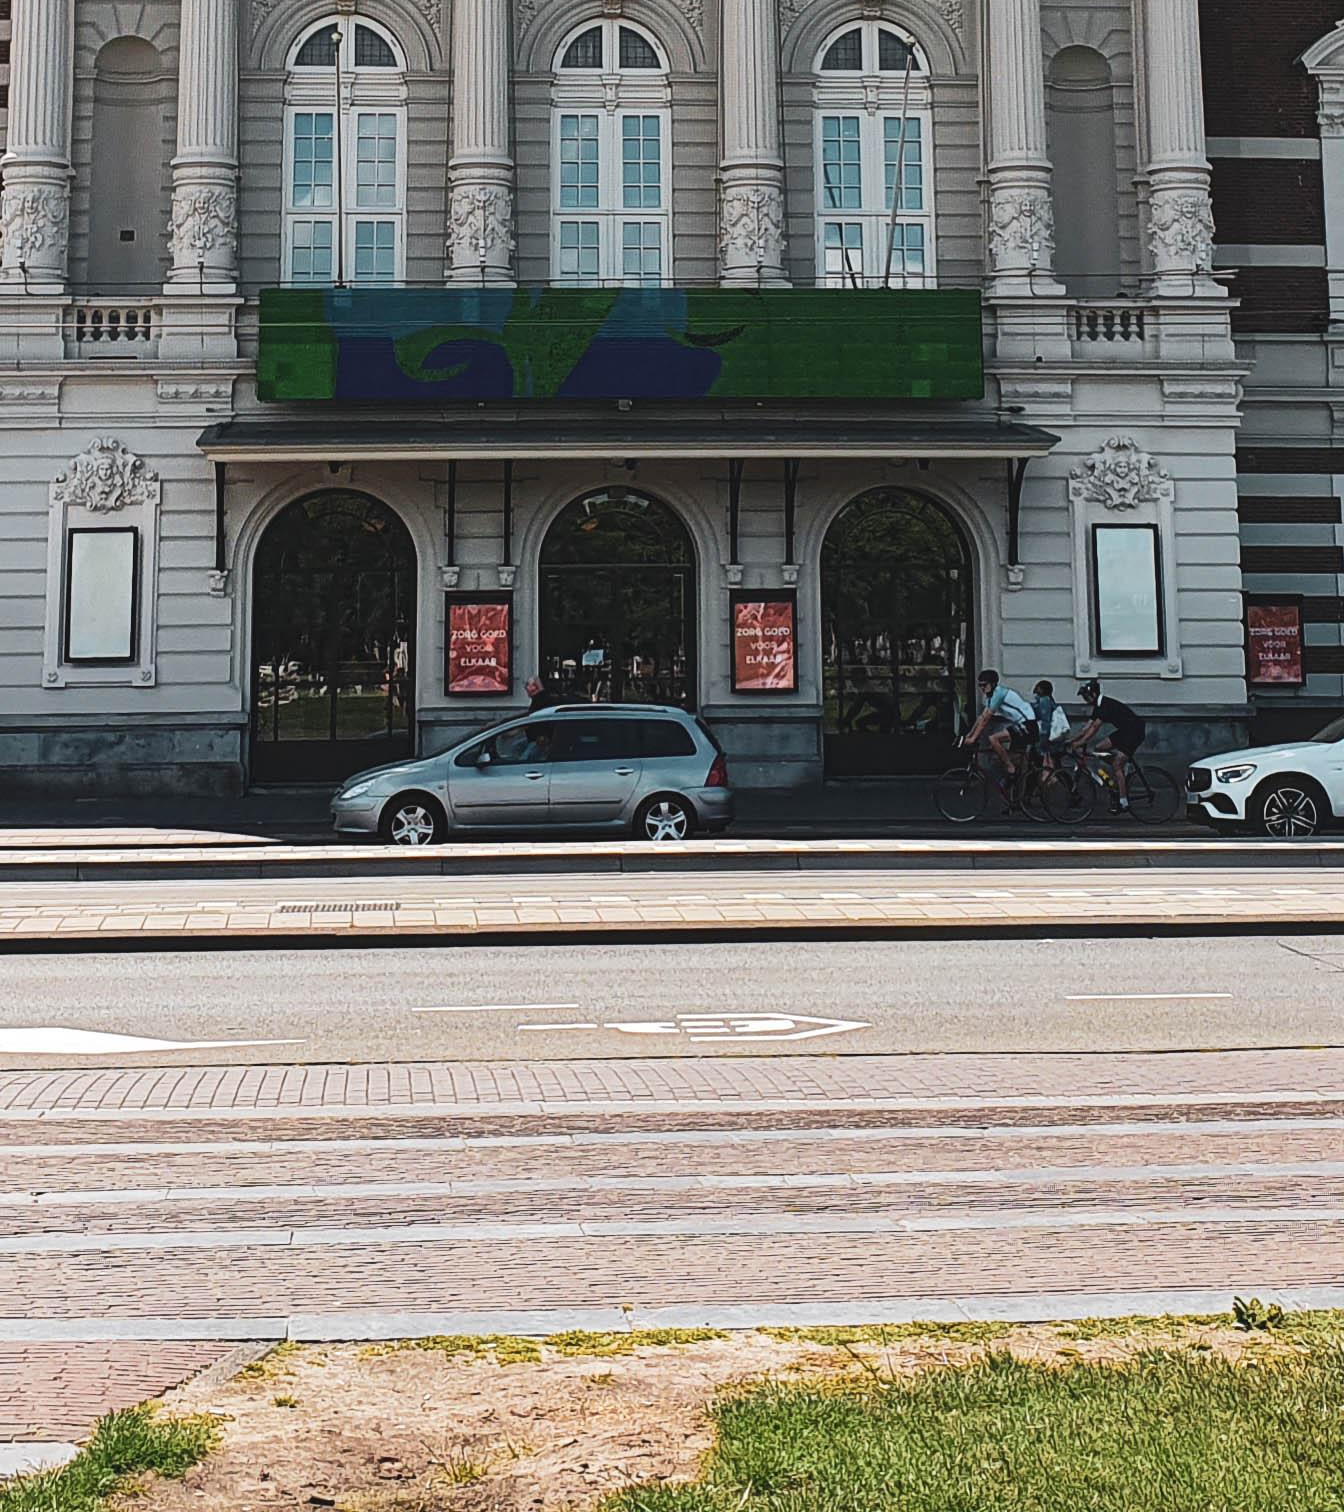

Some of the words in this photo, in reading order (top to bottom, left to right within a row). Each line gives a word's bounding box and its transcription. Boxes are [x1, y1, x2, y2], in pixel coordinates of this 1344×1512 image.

[452, 630, 478, 639] ZORG
[480, 630, 506, 638] GOED
[736, 628, 763, 637] ZORG
[764, 627, 790, 636] GOED
[750, 641, 778, 649] VOOR
[460, 657, 497, 666] ELKAAR
[745, 655, 783, 664] ELKAAR
